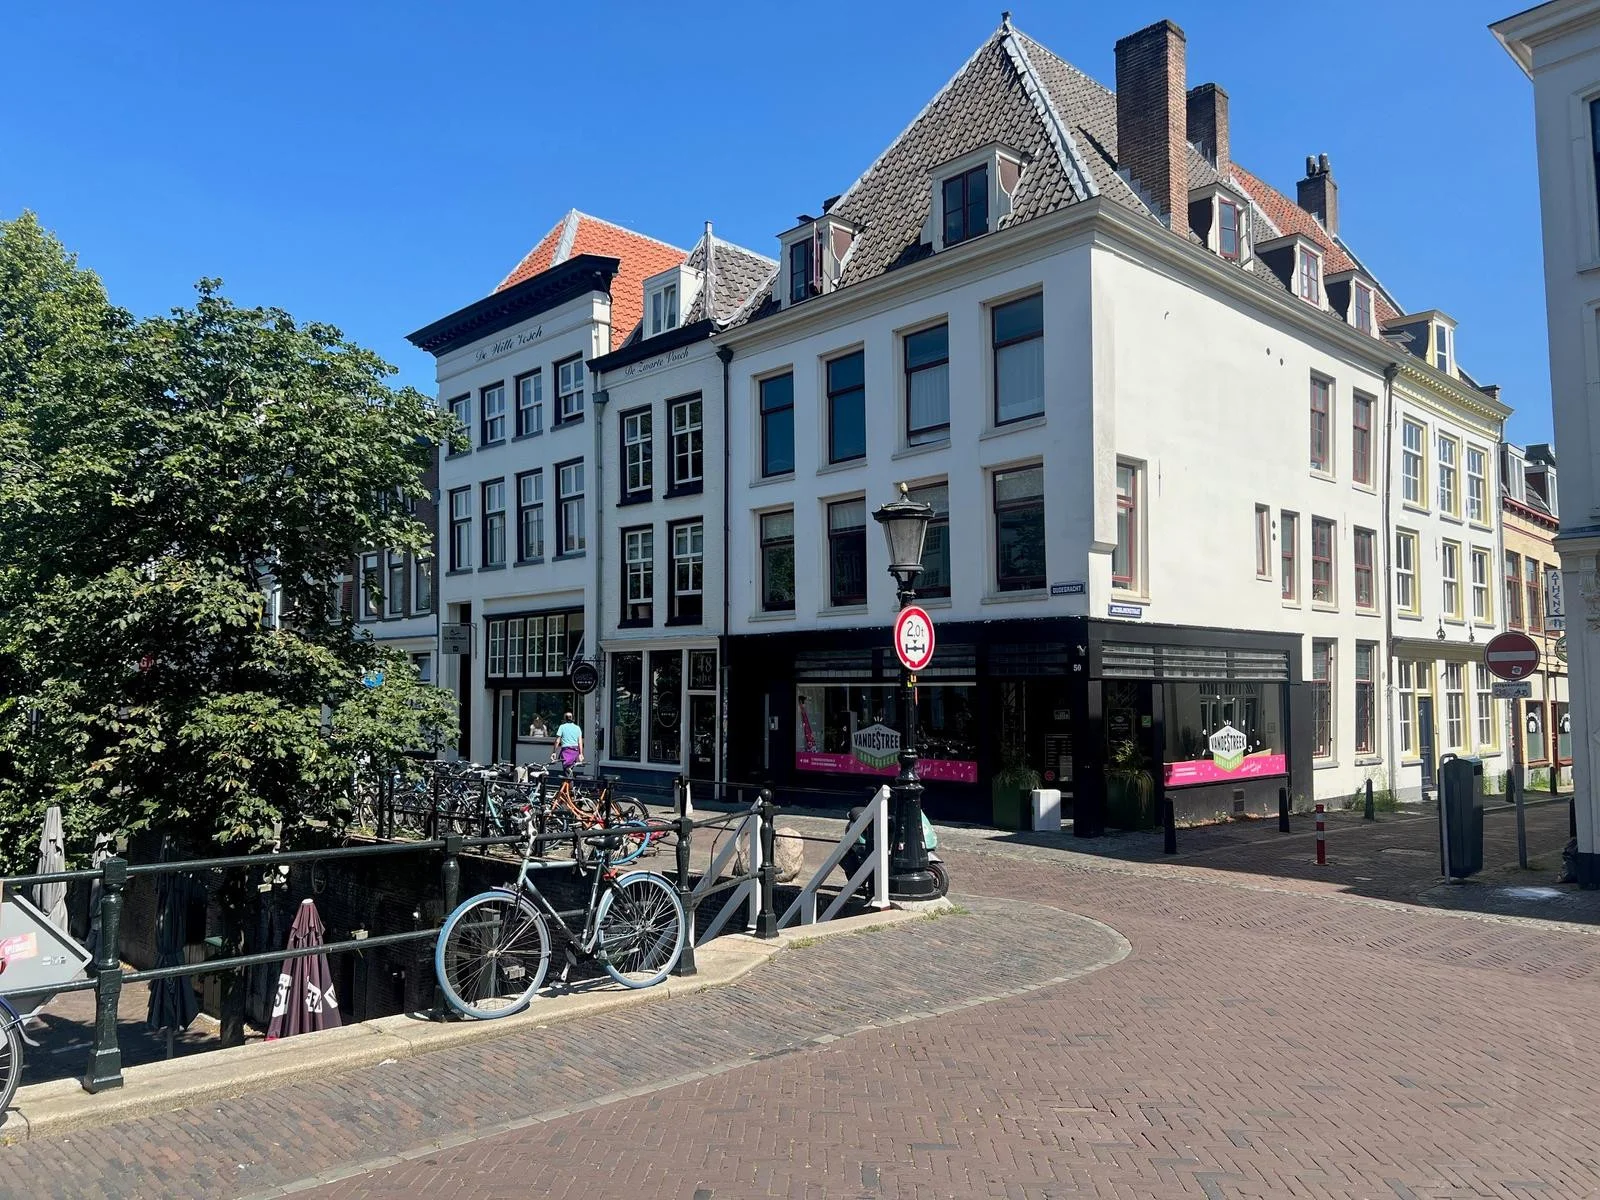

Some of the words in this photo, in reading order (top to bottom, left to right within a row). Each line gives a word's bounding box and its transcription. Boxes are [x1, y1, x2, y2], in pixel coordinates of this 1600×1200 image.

[1052, 585, 1082, 594] OUDEGRACHT
[1073, 663, 1082, 672] 50
[853, 731, 899, 750] VANDESTREE
[1210, 733, 1246, 752] VANDESTREEK
